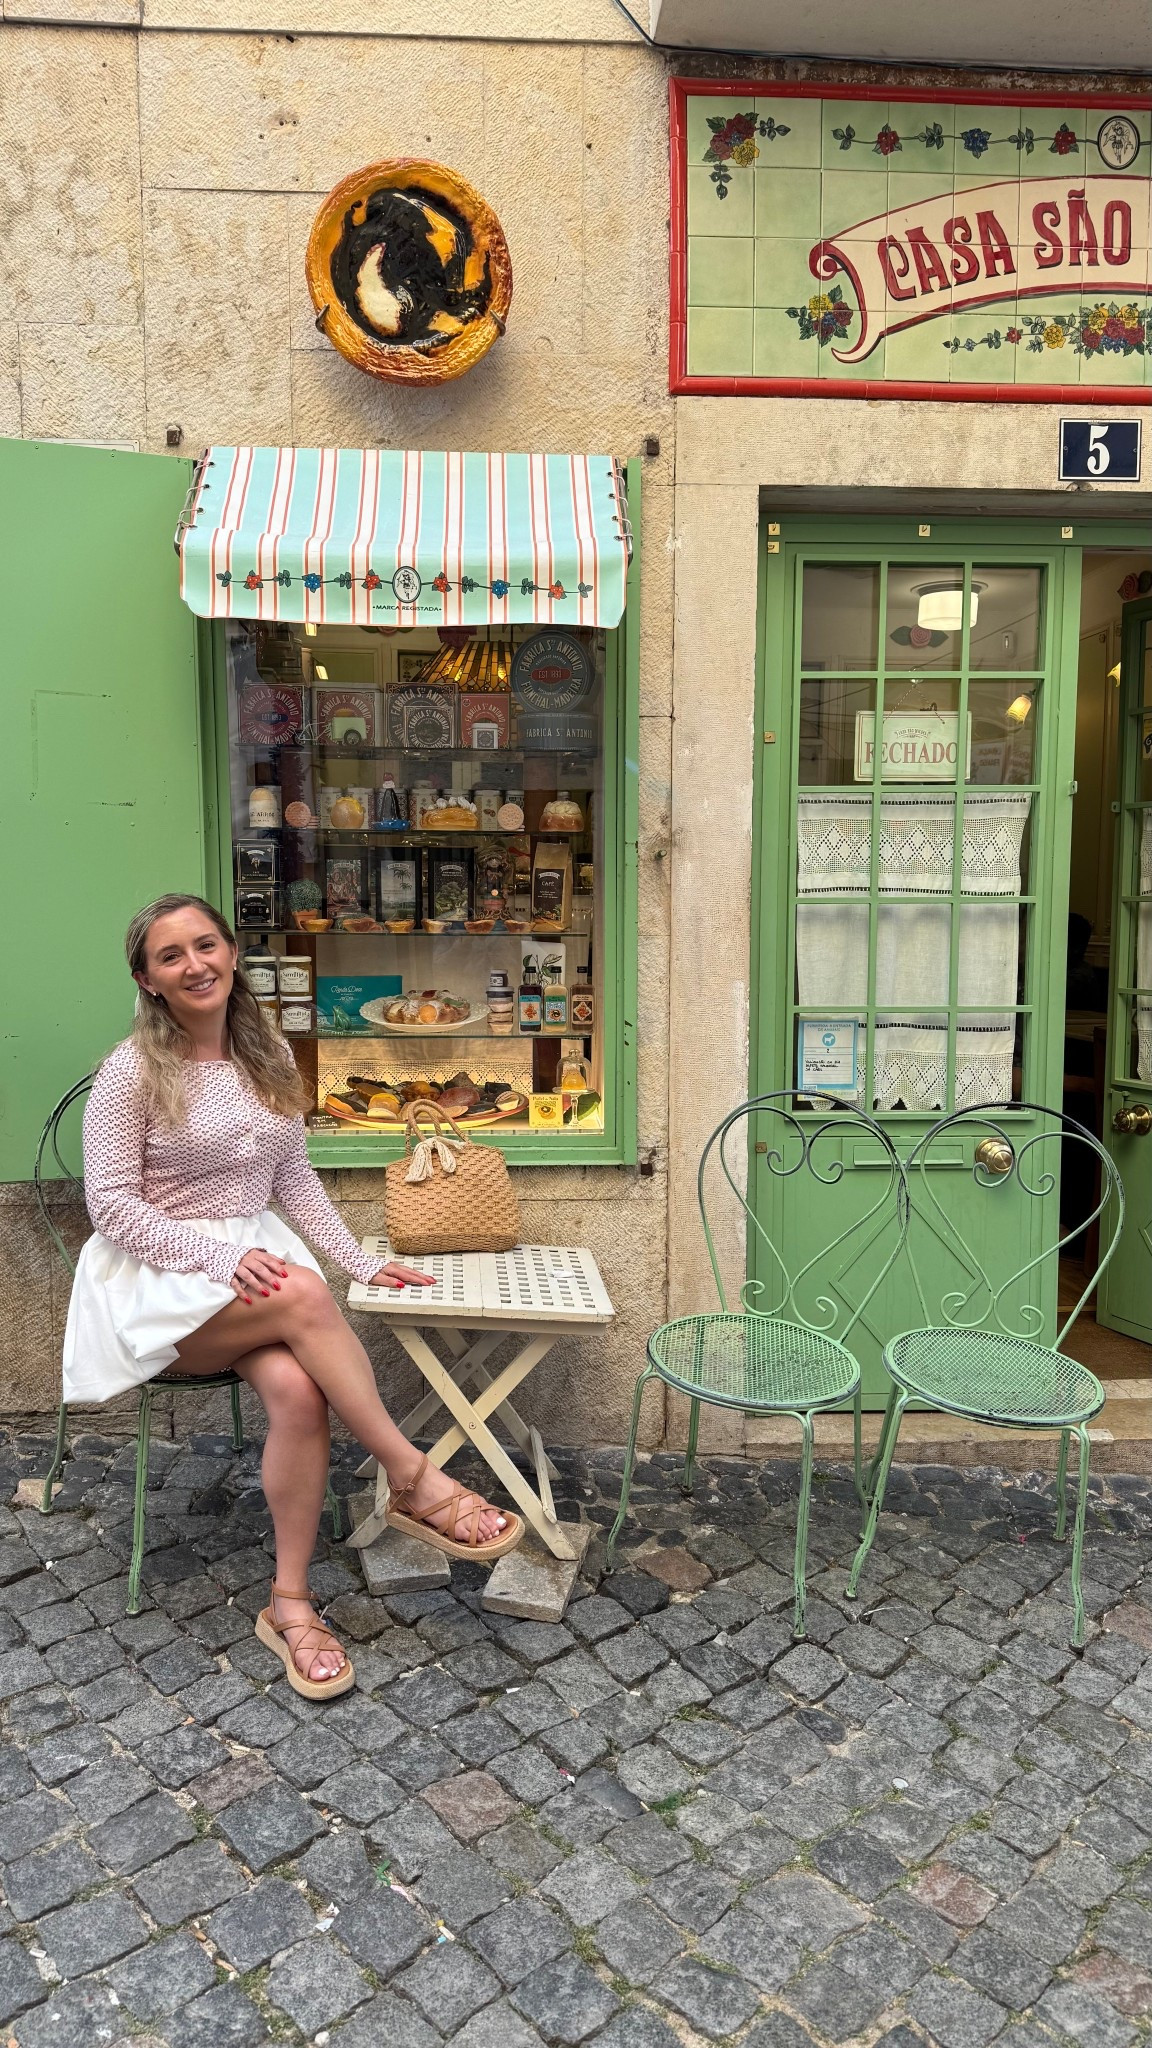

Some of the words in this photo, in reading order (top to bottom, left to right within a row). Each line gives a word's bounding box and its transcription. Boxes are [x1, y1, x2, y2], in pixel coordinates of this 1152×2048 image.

[876, 209, 1016, 302] CASA
[1032, 189, 1132, 269] SÃO
[1087, 425, 1110, 475] 5
[864, 741, 959, 764] FECHADO
